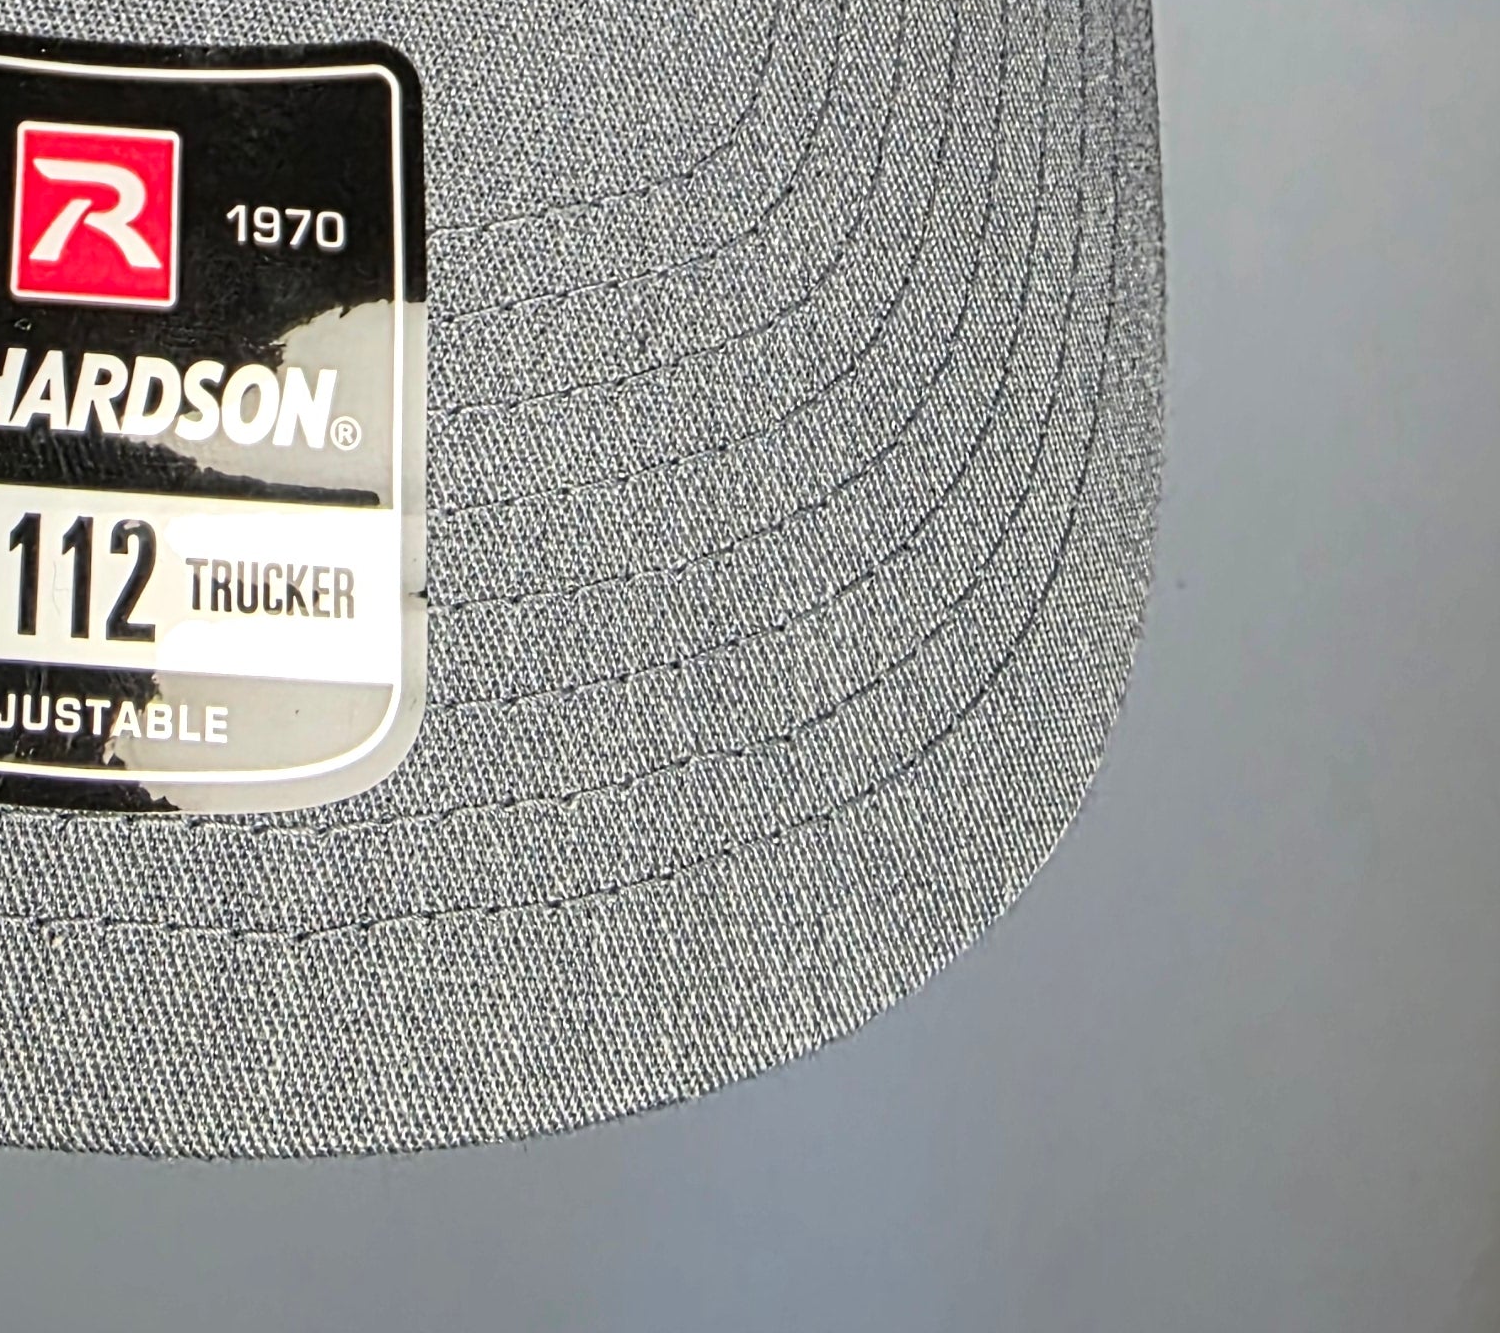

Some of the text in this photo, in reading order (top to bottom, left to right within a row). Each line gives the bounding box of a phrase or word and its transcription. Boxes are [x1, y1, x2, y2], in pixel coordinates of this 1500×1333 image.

[225, 203, 347, 250] 1970
[8, 511, 160, 646] 112
[184, 556, 356, 621] TRUCKER
